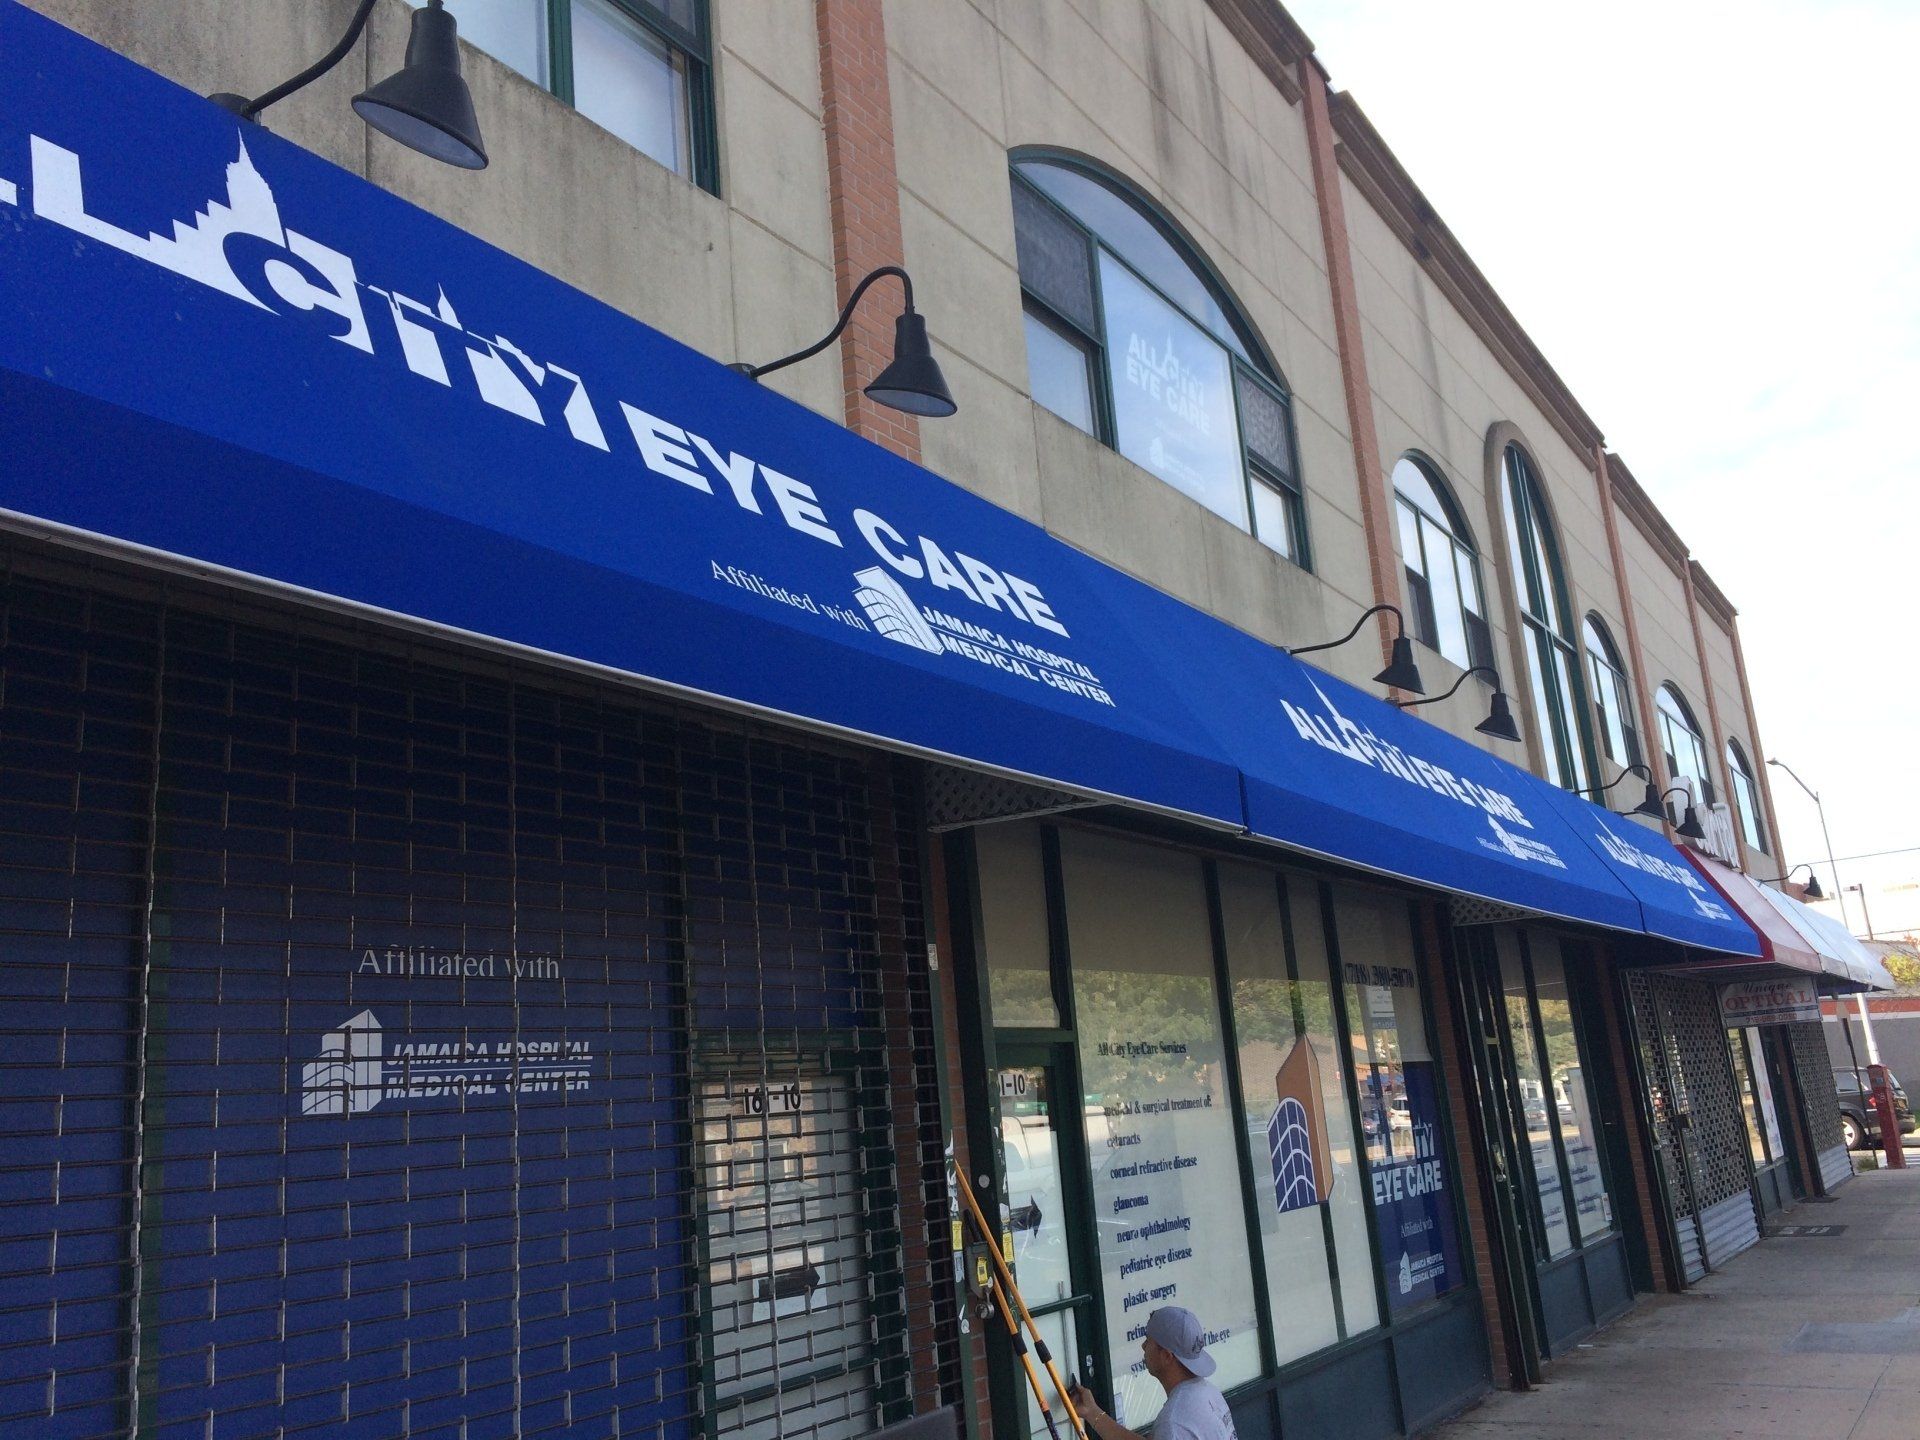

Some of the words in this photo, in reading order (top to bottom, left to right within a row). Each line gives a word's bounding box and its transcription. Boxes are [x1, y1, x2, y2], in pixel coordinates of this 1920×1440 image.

[1128, 332, 1168, 380] ALL
[1127, 355, 1161, 400] EYE
[1166, 387, 1210, 435] CARE
[619, 401, 844, 548] EYE
[853, 508, 1071, 639] CARE
[711, 560, 820, 615] Affiliated
[820, 603, 871, 632] with
[922, 605, 1014, 653] JAMAICA
[1011, 639, 1101, 683] HOSPITAL
[938, 633, 1040, 682] MEDICAL
[1039, 669, 1116, 707] CENTER
[1408, 755, 1477, 807] EYE
[1461, 777, 1534, 829] CARE
[358, 944, 494, 977] Affiliated
[504, 948, 560, 979] with
[1726, 990, 1812, 1011] OPTICAL
[386, 1043, 489, 1066] JAMAICA
[496, 1041, 594, 1063] HOSPITAL
[1140, 1041, 1158, 1055] Care
[1159, 1040, 1187, 1054] Services
[385, 1072, 498, 1099] MEDICAL
[504, 1070, 591, 1093] CENTER
[1134, 1100, 1141, 1114] &
[1142, 1099, 1170, 1115] surgical
[1171, 1097, 1203, 1111] treatment
[1107, 1133, 1141, 1148] cataracts
[1110, 1162, 1138, 1179] corneal
[1139, 1158, 1173, 1175] refractive
[1173, 1156, 1197, 1169] disease
[1372, 1168, 1404, 1206] EYE
[1406, 1160, 1443, 1198] CARE
[1117, 1229, 1139, 1243] neuro
[1140, 1216, 1191, 1240] ophthalmology
[1120, 1254, 1153, 1279] pediatric
[1155, 1254, 1166, 1269] eye
[1167, 1247, 1193, 1262] disease
[1123, 1288, 1149, 1312] plastic
[1150, 1283, 1177, 1300] surgery
[1207, 1329, 1218, 1345] the
[1219, 1328, 1230, 1343] eye
